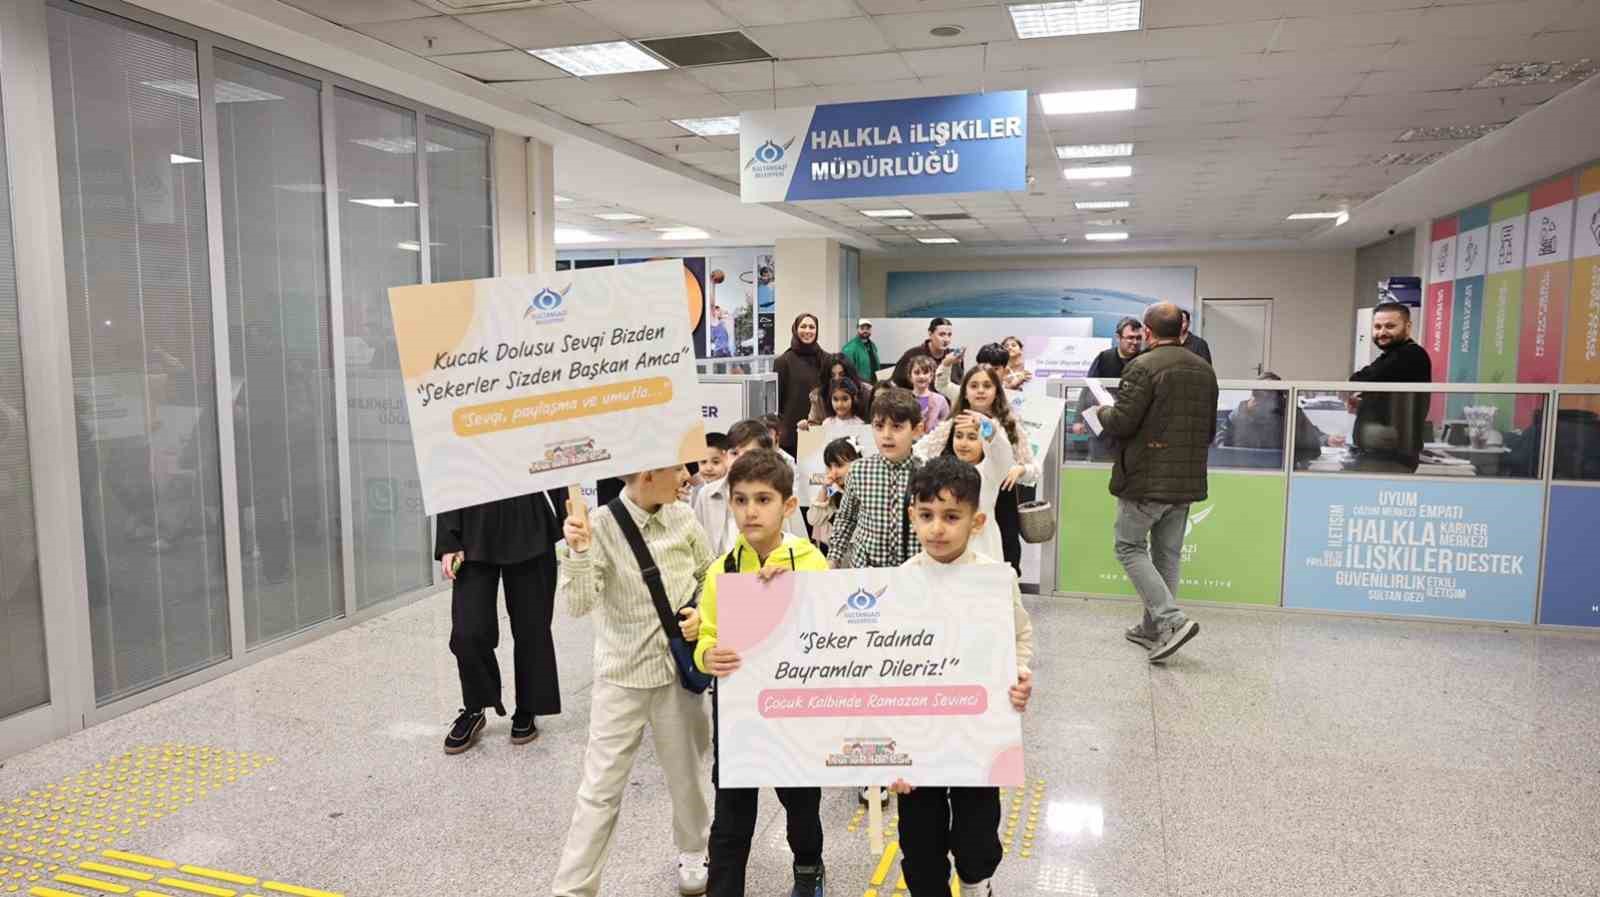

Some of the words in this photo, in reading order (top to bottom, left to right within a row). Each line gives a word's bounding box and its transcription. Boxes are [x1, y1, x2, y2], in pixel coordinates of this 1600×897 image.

[812, 126, 903, 150] HALKLA
[811, 152, 960, 181] MÜDÜRLÜĞÜ
[432, 347, 489, 371] Kucak
[495, 339, 555, 362] Dolusu
[560, 331, 606, 353] Sevgi
[610, 324, 665, 346] Bizden
[506, 367, 563, 391] Sizden
[569, 359, 630, 381] Başkan
[1378, 490, 1418, 507] UYUM
[1347, 518, 1436, 547] HALKLA
[1456, 551, 1524, 576] DESTEK
[865, 628, 934, 649] Tadında
[774, 660, 873, 684] Bayramlar
[763, 694, 804, 712] Çocuk
[807, 692, 863, 711] Kalbinde
[866, 692, 929, 709] Ramazan
[931, 690, 979, 708] Sevinci
